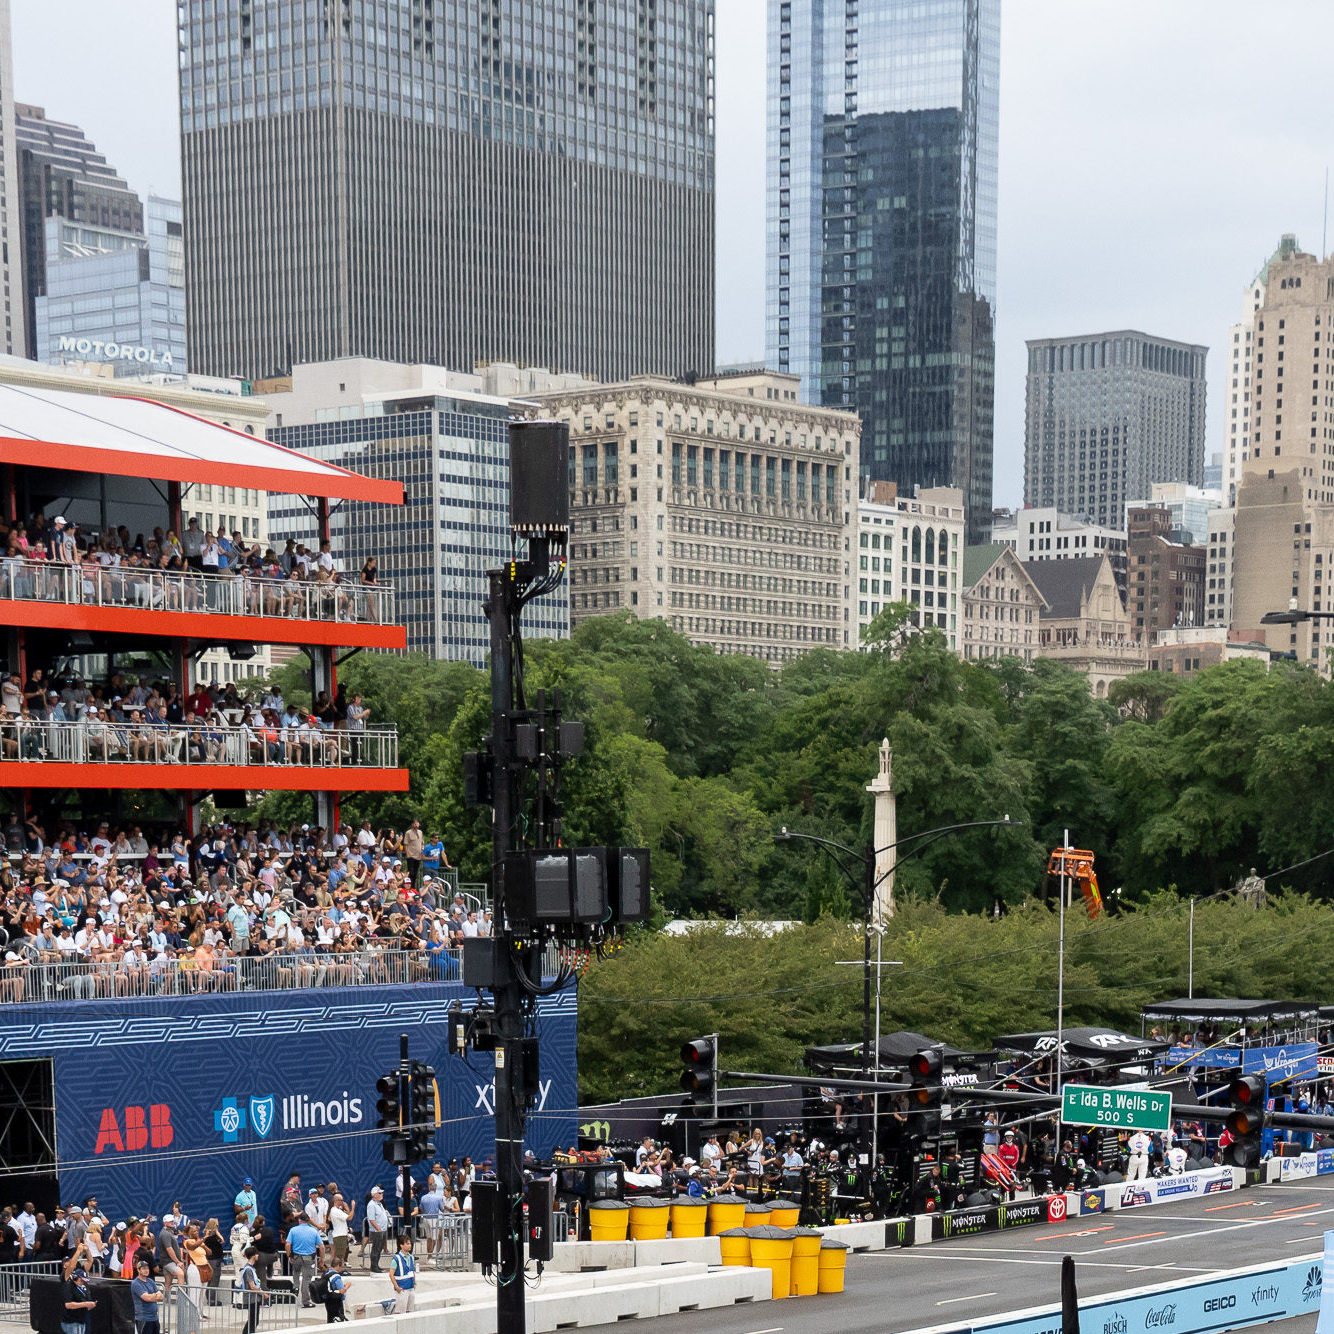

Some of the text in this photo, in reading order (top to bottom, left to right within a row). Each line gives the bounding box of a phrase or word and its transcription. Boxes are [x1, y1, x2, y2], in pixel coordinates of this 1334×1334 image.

[59, 335, 173, 366] MOTOROLA
[1033, 1036, 1070, 1053] RFK
[1275, 1050, 1300, 1078] Kroger
[941, 1073, 979, 1087] MONSTER
[282, 1091, 363, 1130] Illinois
[1069, 1094, 1076, 1104] E
[1080, 1093, 1098, 1107] Ida
[1116, 1094, 1147, 1111] Wells
[1151, 1100, 1164, 1112] Dr
[1096, 1111, 1134, 1123] 500 S
[95, 1104, 174, 1154] ABB
[1157, 1175, 1199, 1188] MAKERS WANTED
[952, 1213, 987, 1230] MONSTER
[1006, 1205, 1040, 1221] MONSTER
[1203, 1295, 1237, 1313] GEICO
[1251, 1284, 1280, 1306] xfinity
[1145, 1304, 1178, 1329] Coca-Cola
